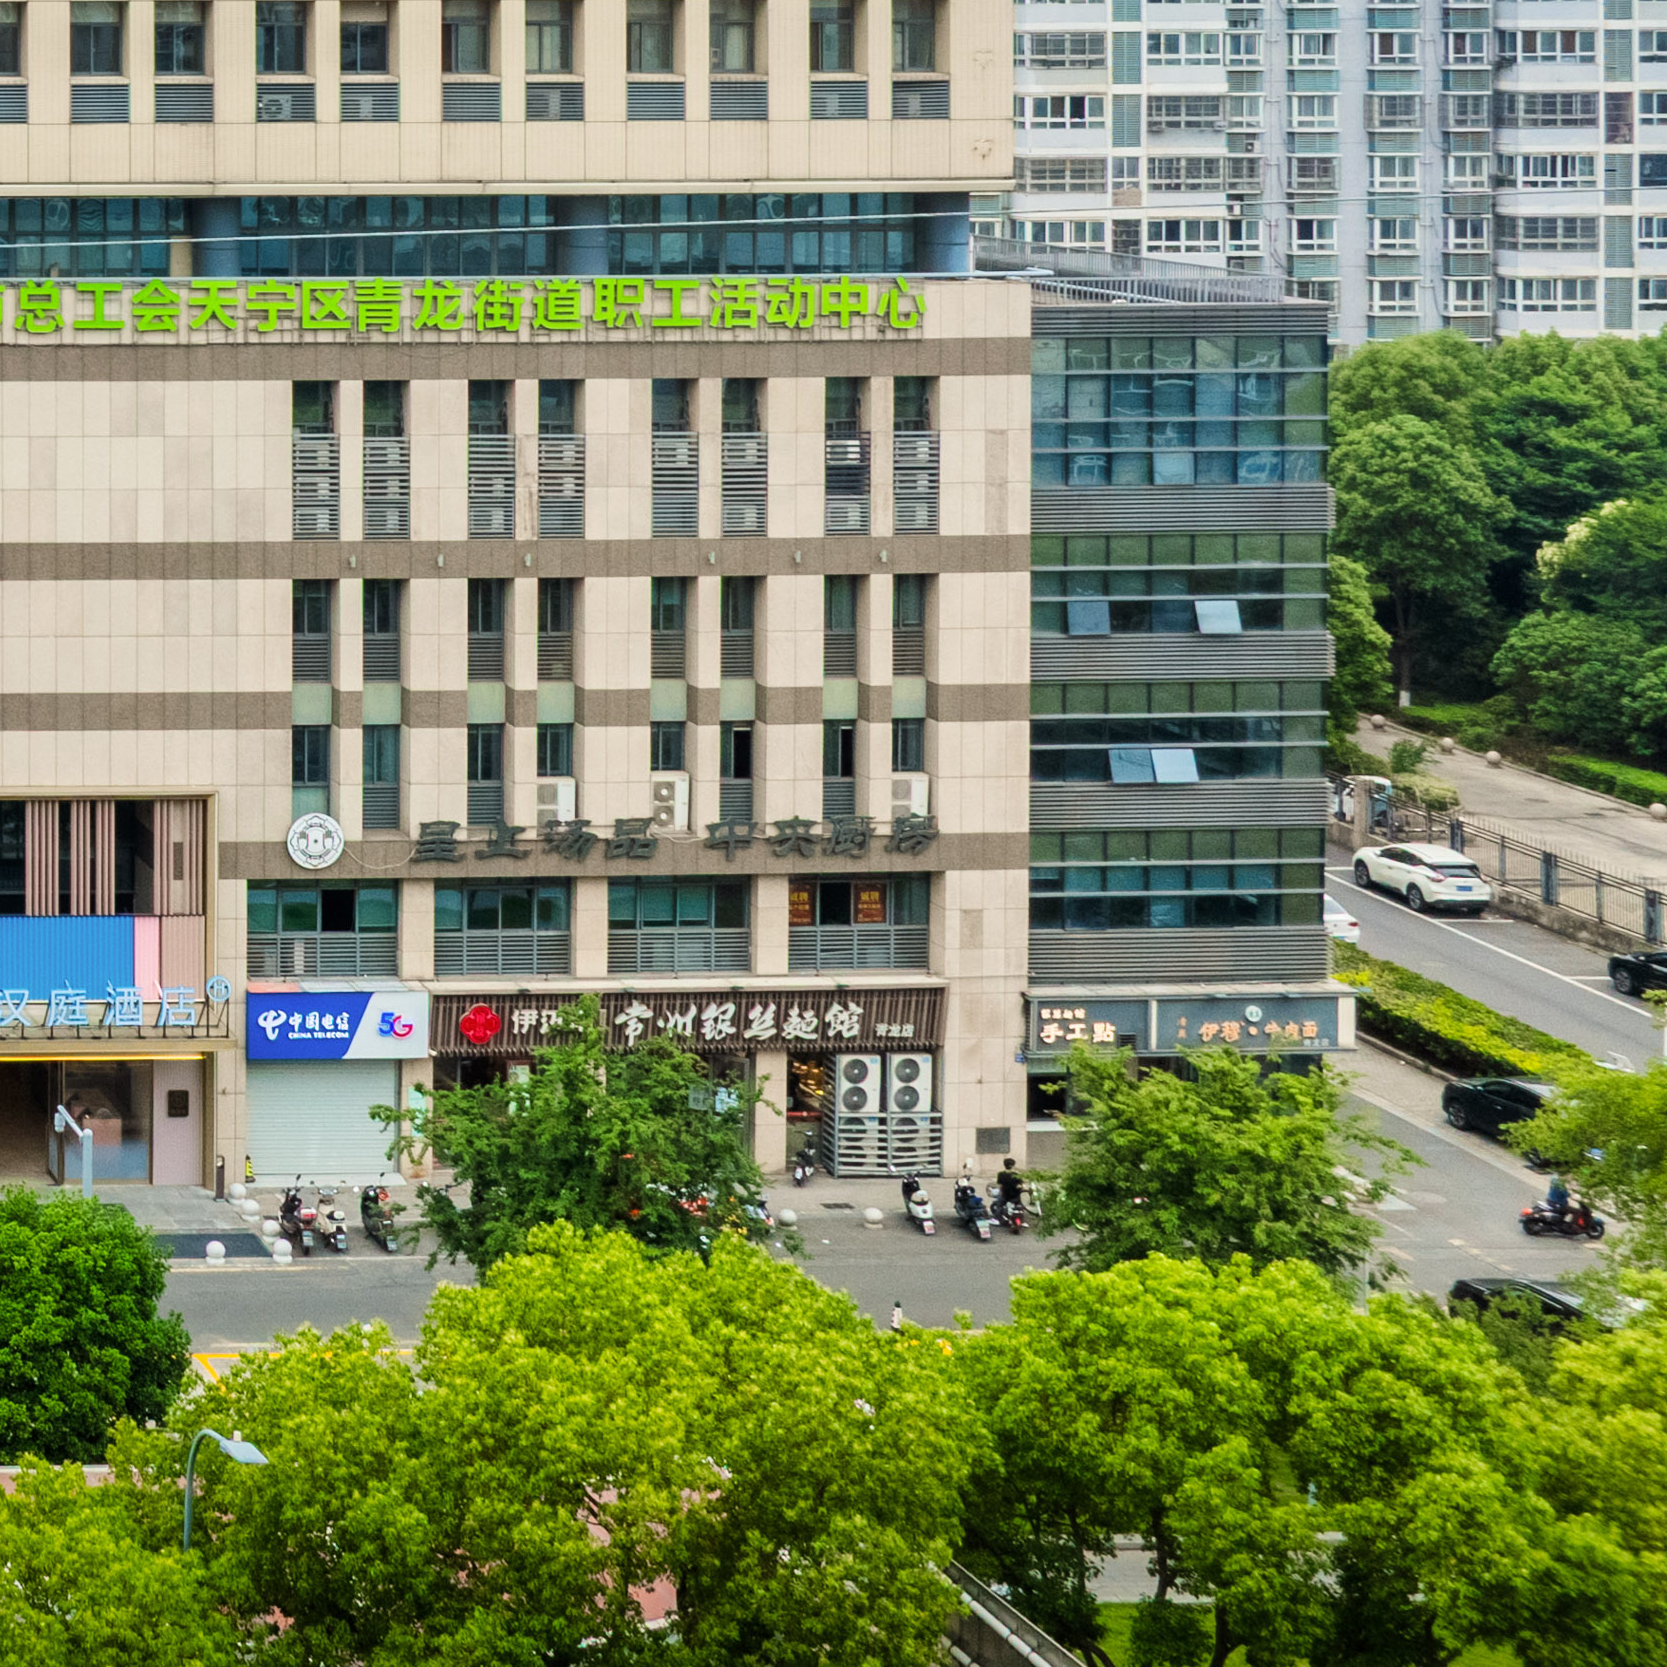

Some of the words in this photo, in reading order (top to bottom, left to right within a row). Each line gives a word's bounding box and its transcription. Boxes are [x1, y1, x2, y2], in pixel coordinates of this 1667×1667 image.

[288, 1010, 350, 1031] 中国电信
[378, 1011, 415, 1039] 5G
